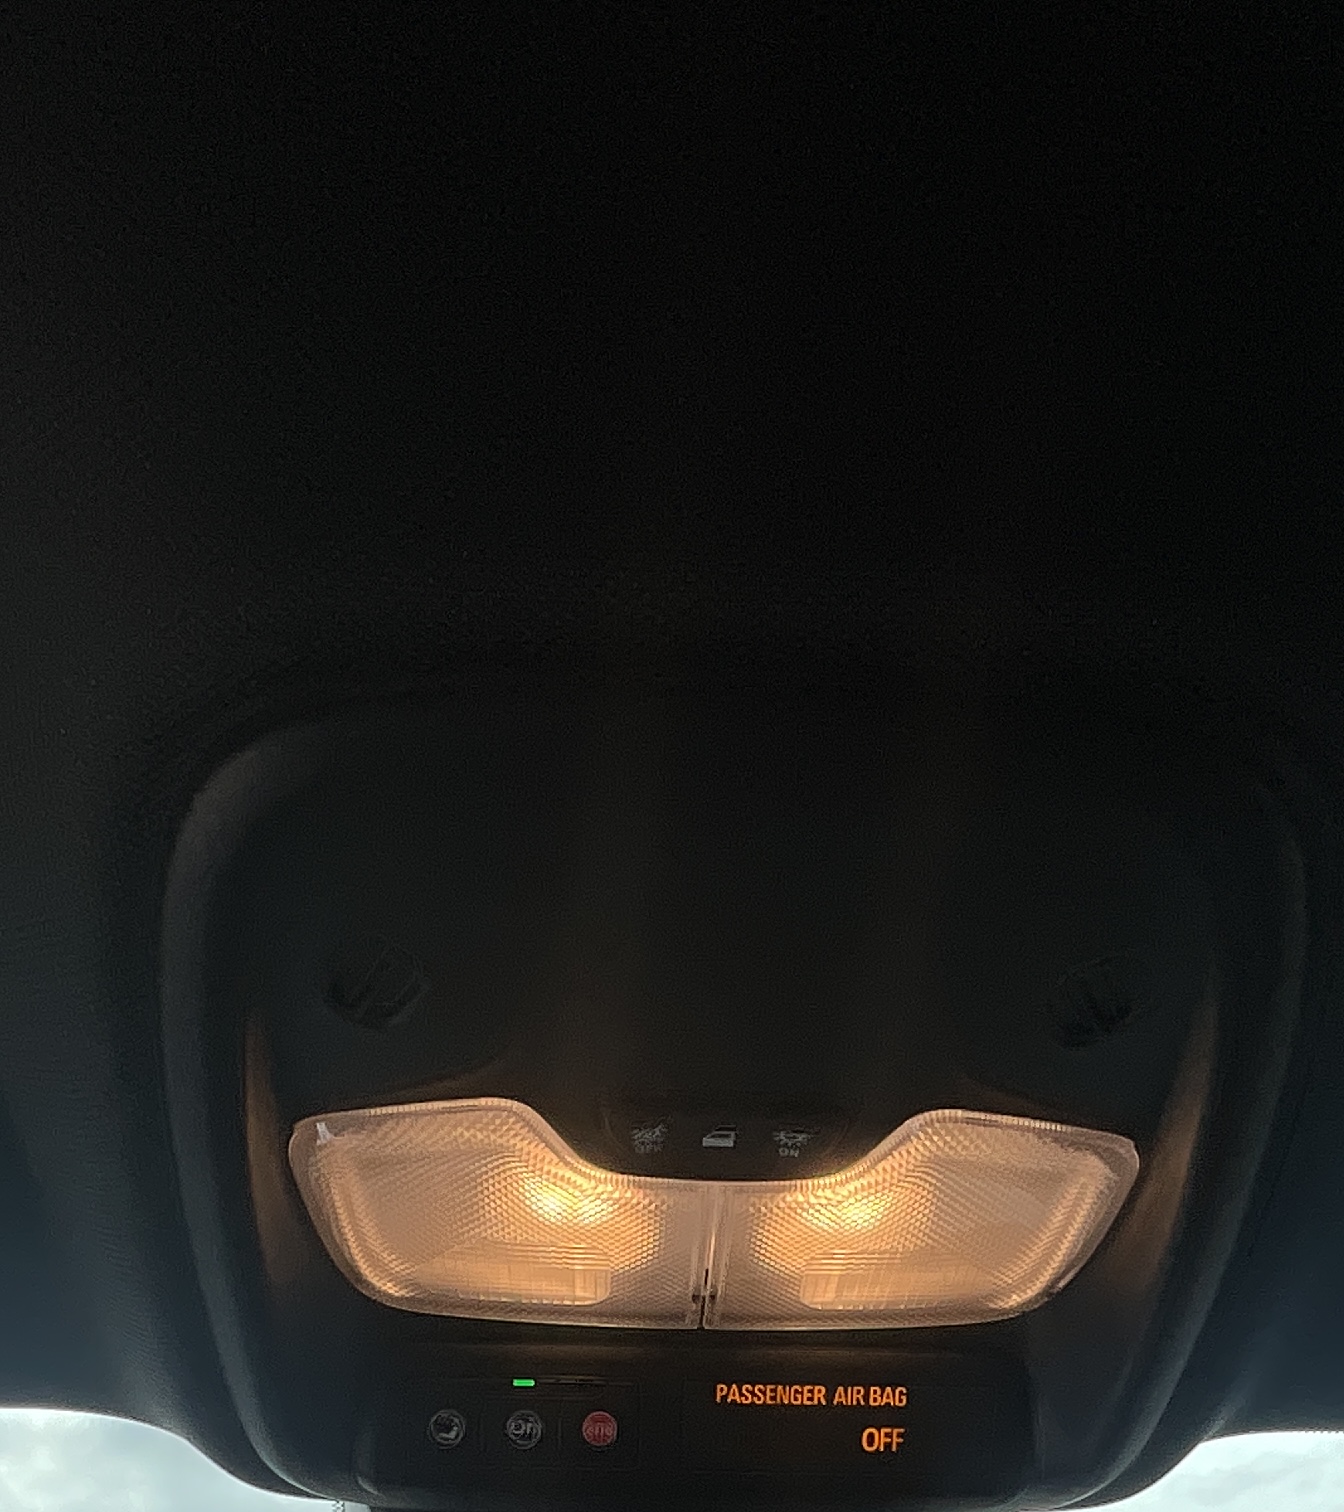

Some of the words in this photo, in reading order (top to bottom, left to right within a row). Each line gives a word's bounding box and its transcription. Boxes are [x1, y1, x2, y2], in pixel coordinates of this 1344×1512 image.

[716, 1384, 827, 1406] PASSENGER
[833, 1386, 865, 1406] AIR
[869, 1387, 907, 1407] BAG
[862, 1427, 906, 1452] OFF
